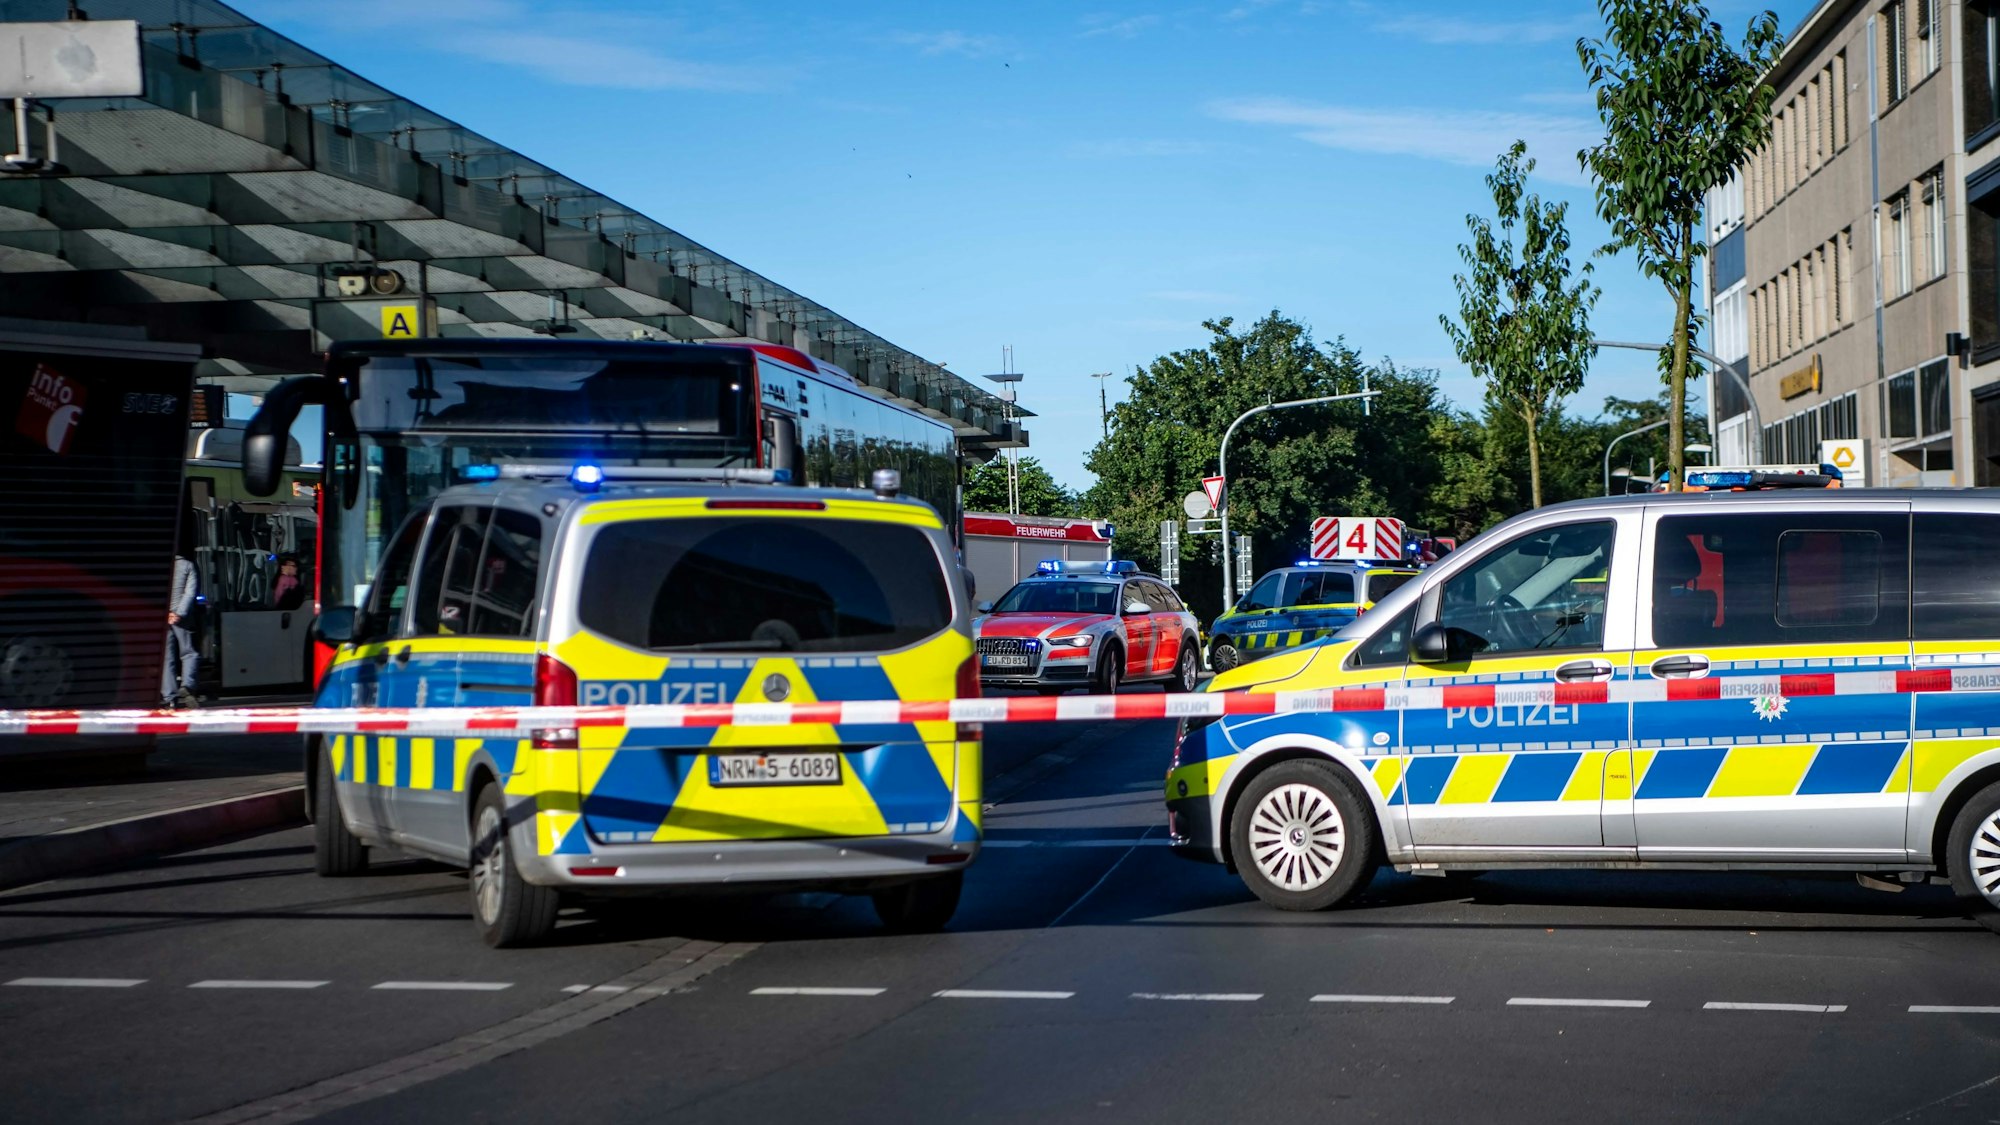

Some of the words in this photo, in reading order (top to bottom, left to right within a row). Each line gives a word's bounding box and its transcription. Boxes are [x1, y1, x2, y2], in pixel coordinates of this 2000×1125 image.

[389, 312, 412, 336] A
[30, 362, 74, 404] info
[1016, 526, 1066, 538] FEUERWEHR
[1346, 523, 1367, 554] 4
[1246, 619, 1268, 629] POLIZEI
[987, 656, 998, 665] EU
[1001, 656, 1012, 665] RD
[1012, 656, 1027, 665] 814
[1447, 703, 1579, 728] POLIZEI
[720, 760, 756, 778] NRW
[767, 758, 834, 777] 5-6089
